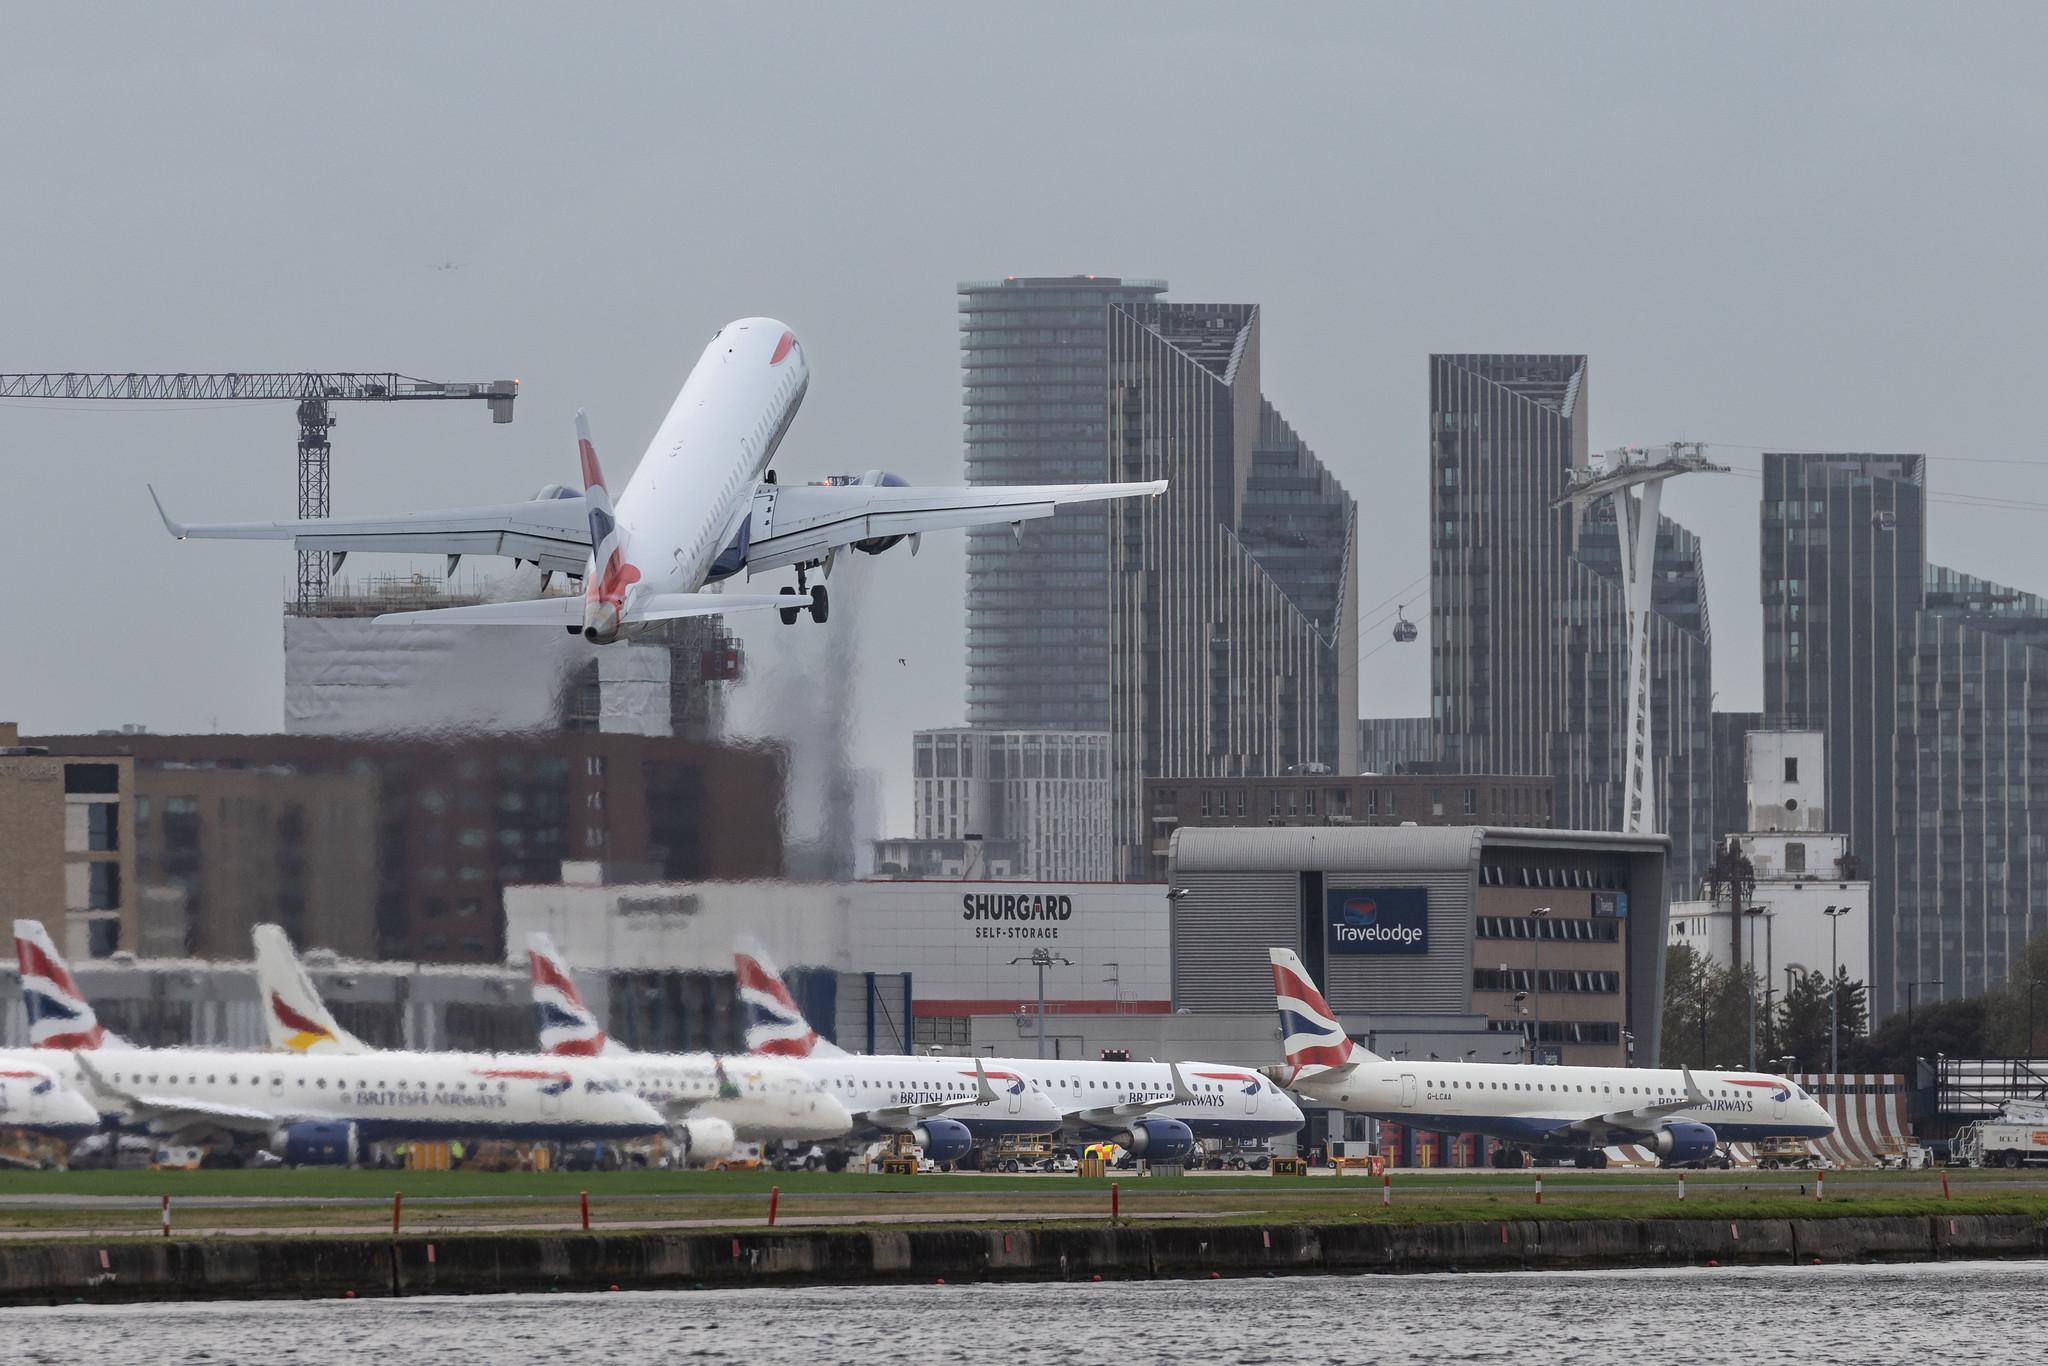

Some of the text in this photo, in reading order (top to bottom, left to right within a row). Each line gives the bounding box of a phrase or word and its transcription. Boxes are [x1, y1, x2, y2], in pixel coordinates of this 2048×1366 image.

[963, 893, 1072, 921] SHURGARD
[975, 927, 1059, 939] SELF-STORAGE
[1333, 923, 1422, 945] Travelodge
[900, 1091, 943, 1105] BRITISH
[1427, 1092, 1452, 1101] G-LCAA
[1703, 1099, 1753, 1112] AIRWAYS
[893, 1164, 905, 1174] T5
[1279, 1162, 1292, 1172] T4
